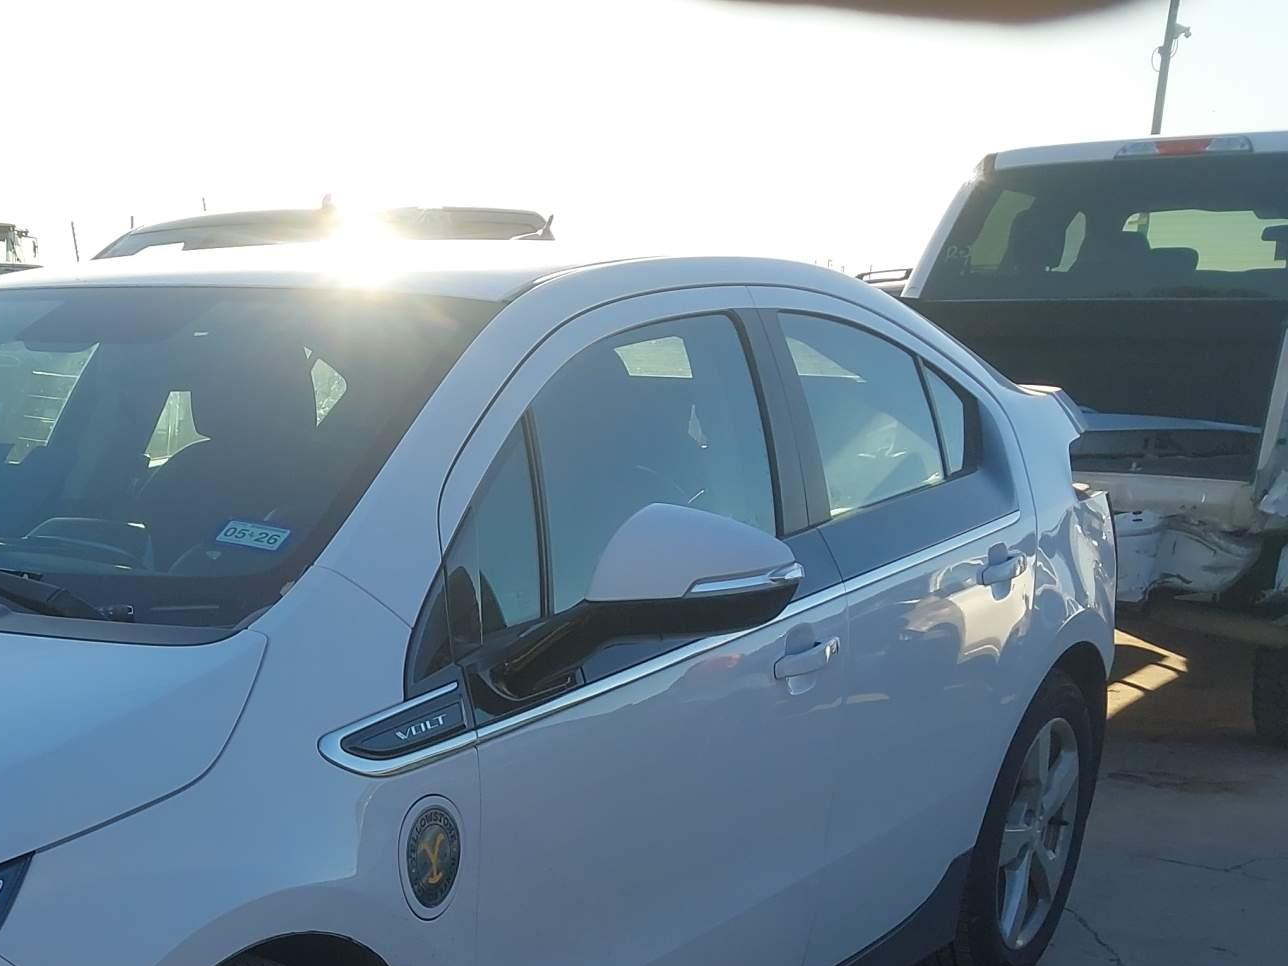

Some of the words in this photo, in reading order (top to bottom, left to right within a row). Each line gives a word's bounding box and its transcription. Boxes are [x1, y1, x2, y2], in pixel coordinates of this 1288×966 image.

[224, 527, 250, 540] 05
[254, 532, 281, 545] 26
[395, 713, 447, 741] VOLT
